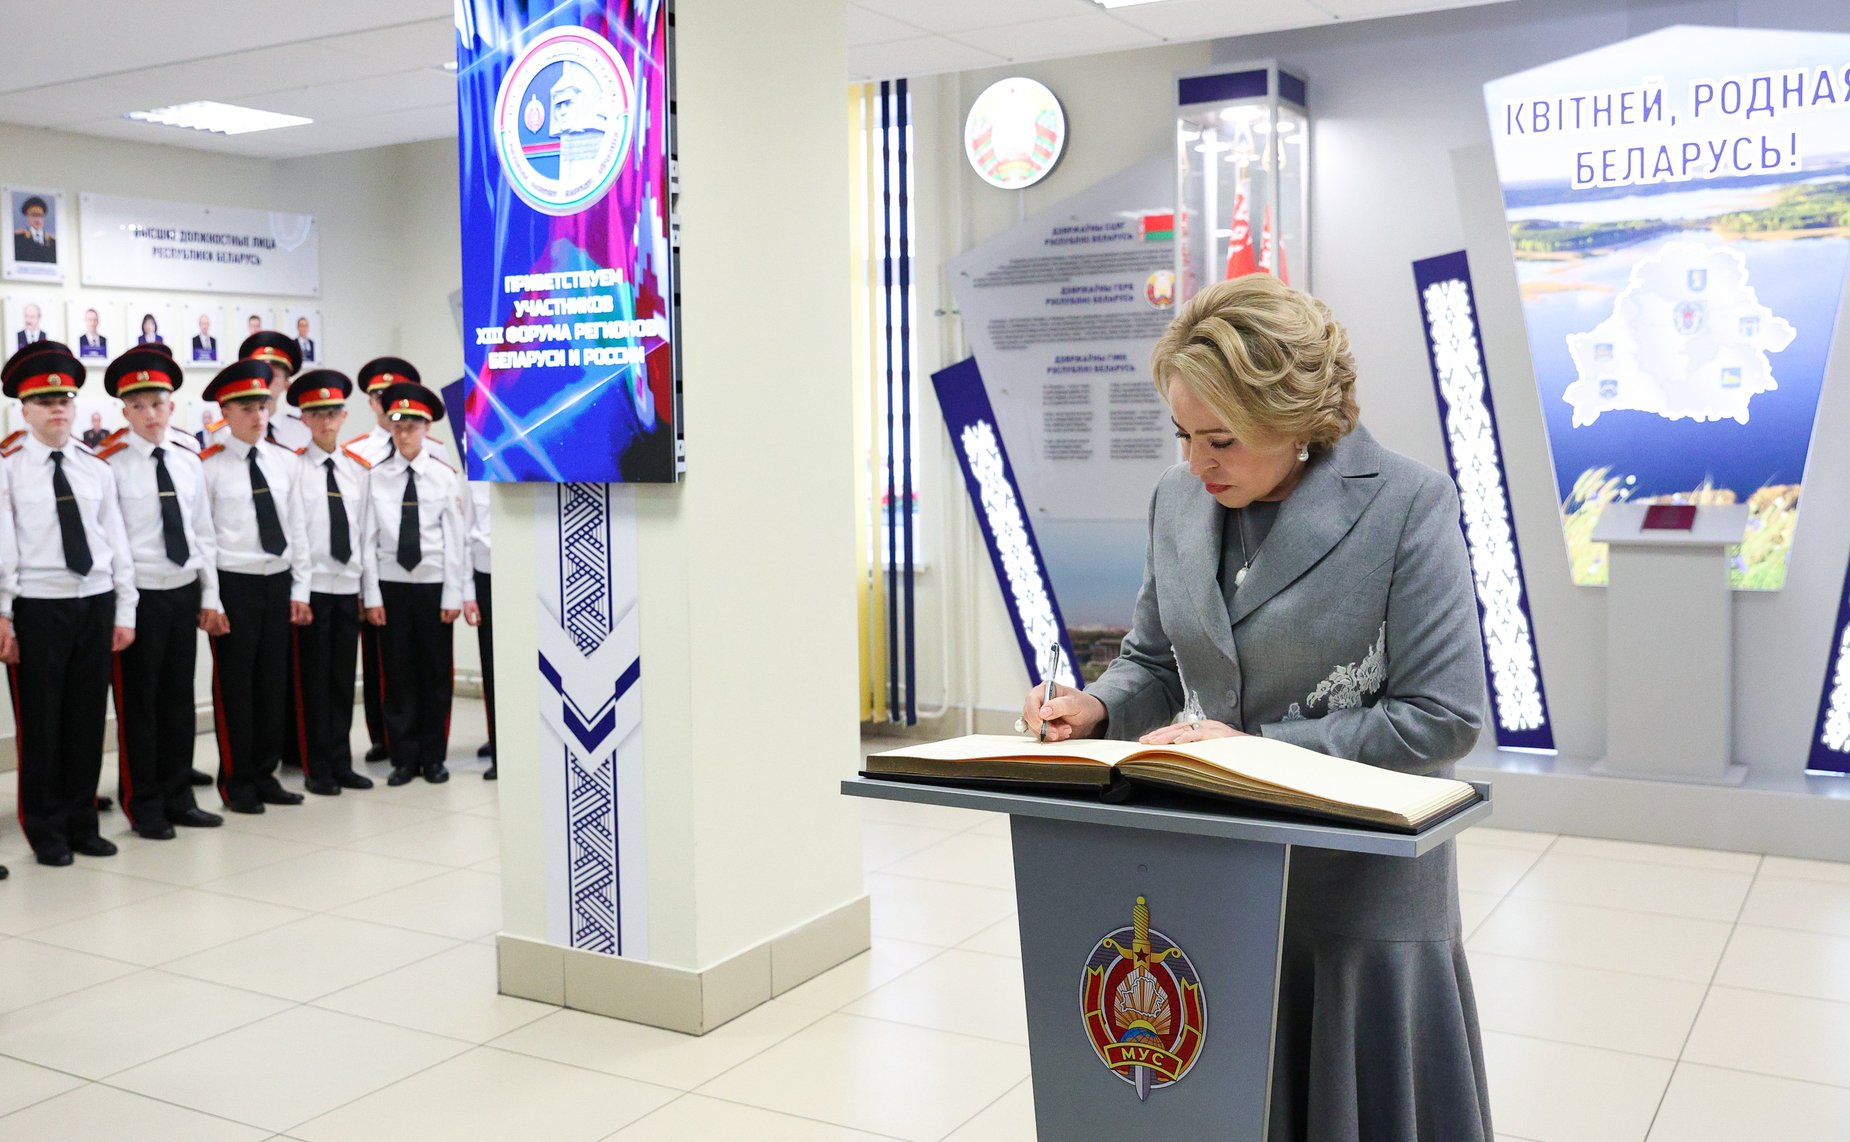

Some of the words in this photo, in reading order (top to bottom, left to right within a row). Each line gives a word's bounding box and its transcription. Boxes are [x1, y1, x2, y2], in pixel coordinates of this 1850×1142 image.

[1506, 80, 1677, 135] КВІТНЕЙ,
[1576, 132, 1797, 184] БЕЛАРУСЬ!
[505, 268, 623, 293] ПРИВЕТСТВУЕМ
[514, 295, 614, 317] УЧАСТНИКОВ
[506, 324, 571, 343] ФОРУМА
[575, 319, 657, 339] РЕГИОНОВ
[488, 350, 565, 369] БЕЛАРУСИ
[569, 349, 580, 366] И
[584, 346, 645, 365] РОССИИ
[1122, 1047, 1164, 1066] МУС
